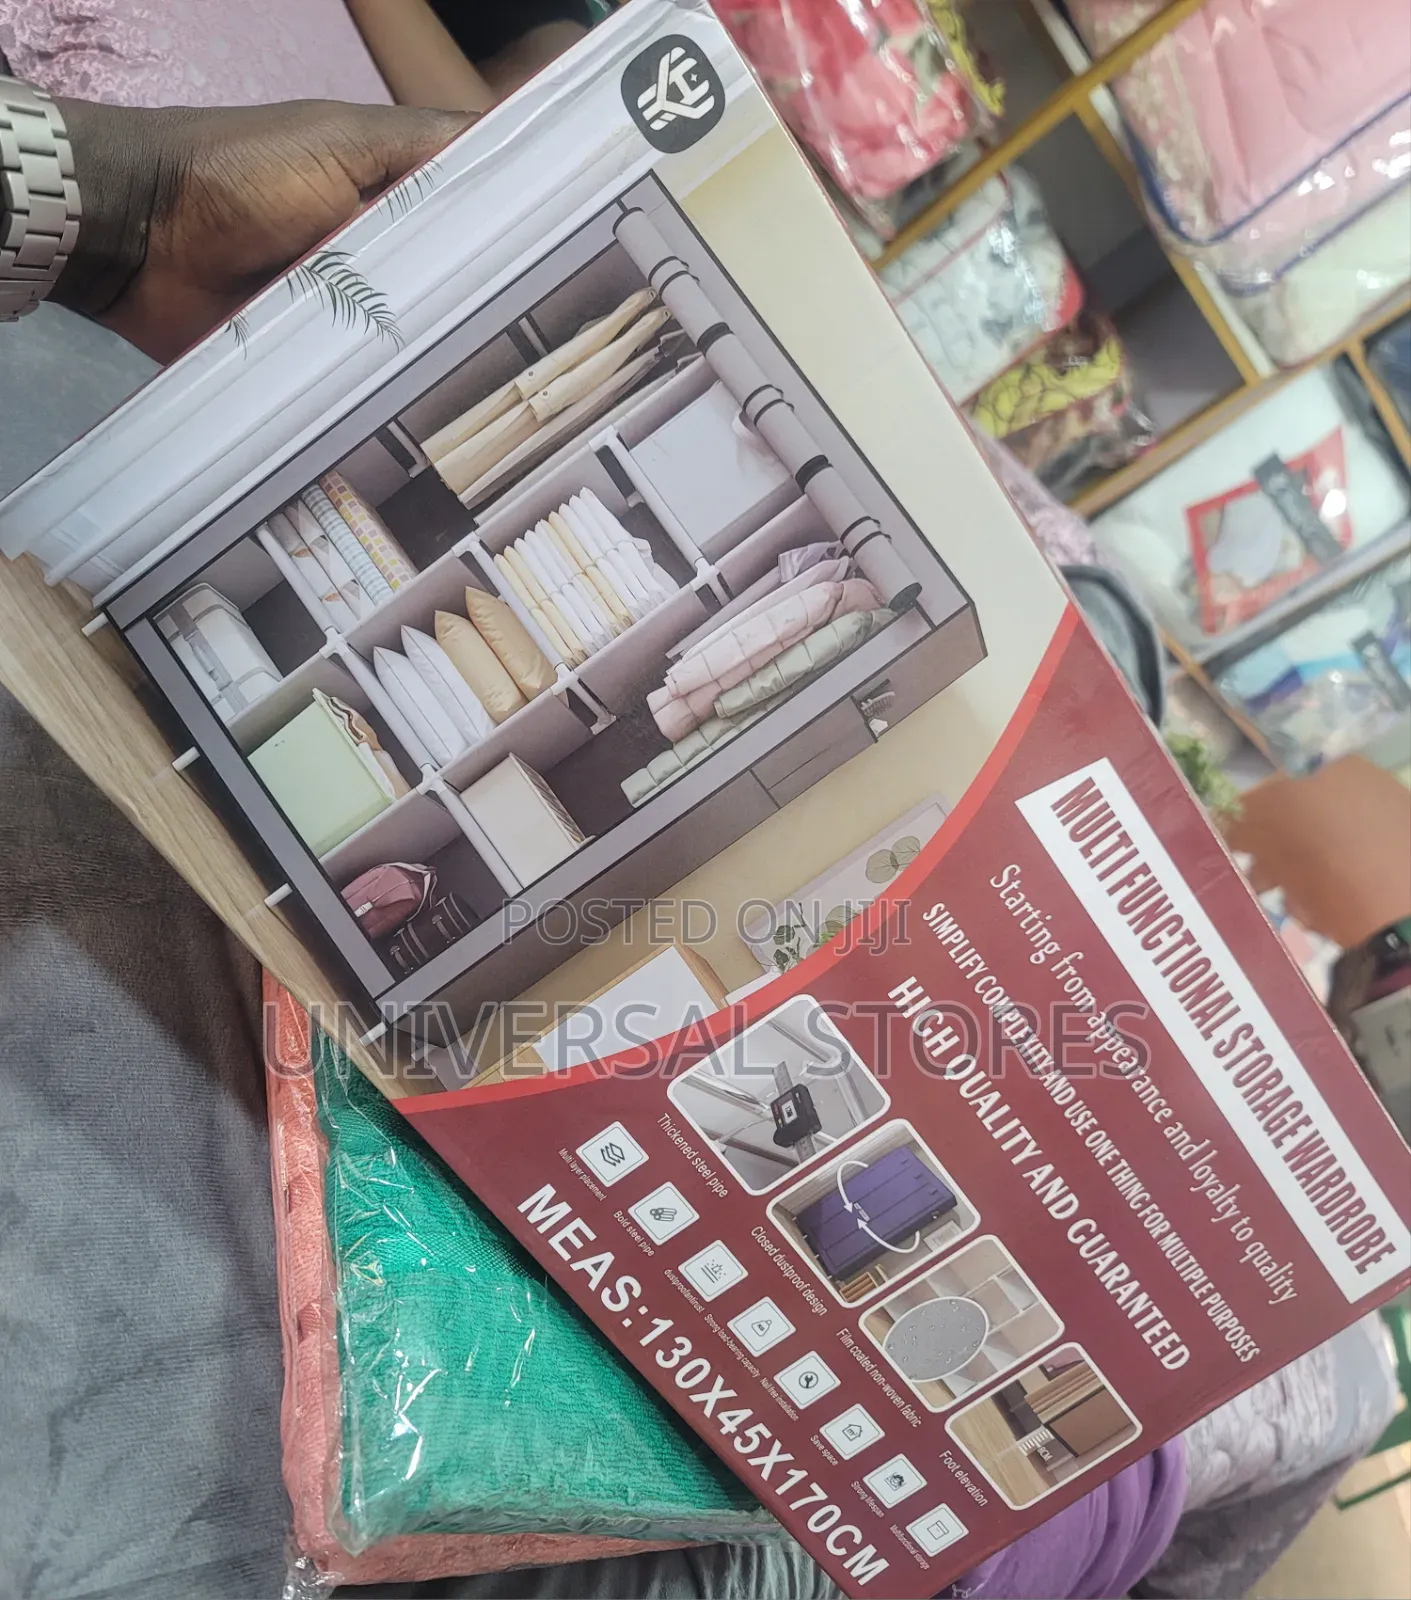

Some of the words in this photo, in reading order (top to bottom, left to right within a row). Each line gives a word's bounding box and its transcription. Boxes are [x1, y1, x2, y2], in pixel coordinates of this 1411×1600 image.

[989, 864, 1061, 965] Starting
[1050, 951, 1096, 1012] from
[1050, 776, 1140, 882] MULTI
[1106, 862, 1241, 1041] FUNCTIONAL
[1212, 1022, 1313, 1150] STORAGE
[1282, 1129, 1397, 1275] WARDROBE
[1087, 1010, 1174, 1124] appearance
[657, 1112, 700, 1160] Thickened
[691, 1157, 717, 1180] steel
[705, 1177, 728, 1198] pipe
[922, 902, 989, 979] SIMPLIFY
[975, 974, 1057, 1074] COMPLEXITY
[1038, 1065, 1079, 1110] AND
[1064, 1099, 1099, 1136] USE
[1084, 1130, 1121, 1167] ONE
[1106, 1158, 1151, 1210] THING
[1137, 1203, 1171, 1239] FOR
[1156, 1231, 1215, 1299] MULTIPLE
[1200, 1292, 1261, 1363] PURPOSES
[1163, 1121, 1211, 1161] and
[558, 1147, 573, 1164] Multi
[569, 1159, 585, 1176] layer
[578, 1173, 607, 1202] placement
[886, 975, 961, 1059] HIGH
[944, 1054, 1043, 1164] QUALITY
[1022, 1163, 1079, 1220] AND
[1067, 1218, 1190, 1370] GUARANTEED
[1188, 1149, 1241, 1223] loyalty
[613, 1210, 632, 1228] Bold
[626, 1226, 645, 1244] steel
[637, 1241, 655, 1257] pipe
[1230, 1216, 1254, 1242] to
[751, 1226, 781, 1257] Closed
[772, 1254, 811, 1292] dustproof
[802, 1288, 828, 1317] design
[1239, 1241, 1298, 1305] quality
[703, 1313, 721, 1333] Strong
[740, 1357, 761, 1378] capacity
[835, 1327, 855, 1349] Film
[849, 1345, 878, 1372] coated
[869, 1369, 906, 1409] non-woven
[899, 1404, 922, 1428] fabric
[767, 1386, 779, 1399] free
[775, 1396, 799, 1421] installation
[810, 1434, 825, 1451] Save
[821, 1448, 839, 1466] space
[938, 1449, 961, 1473] Foot
[954, 1470, 988, 1507] elevation
[850, 1480, 869, 1501] Strong
